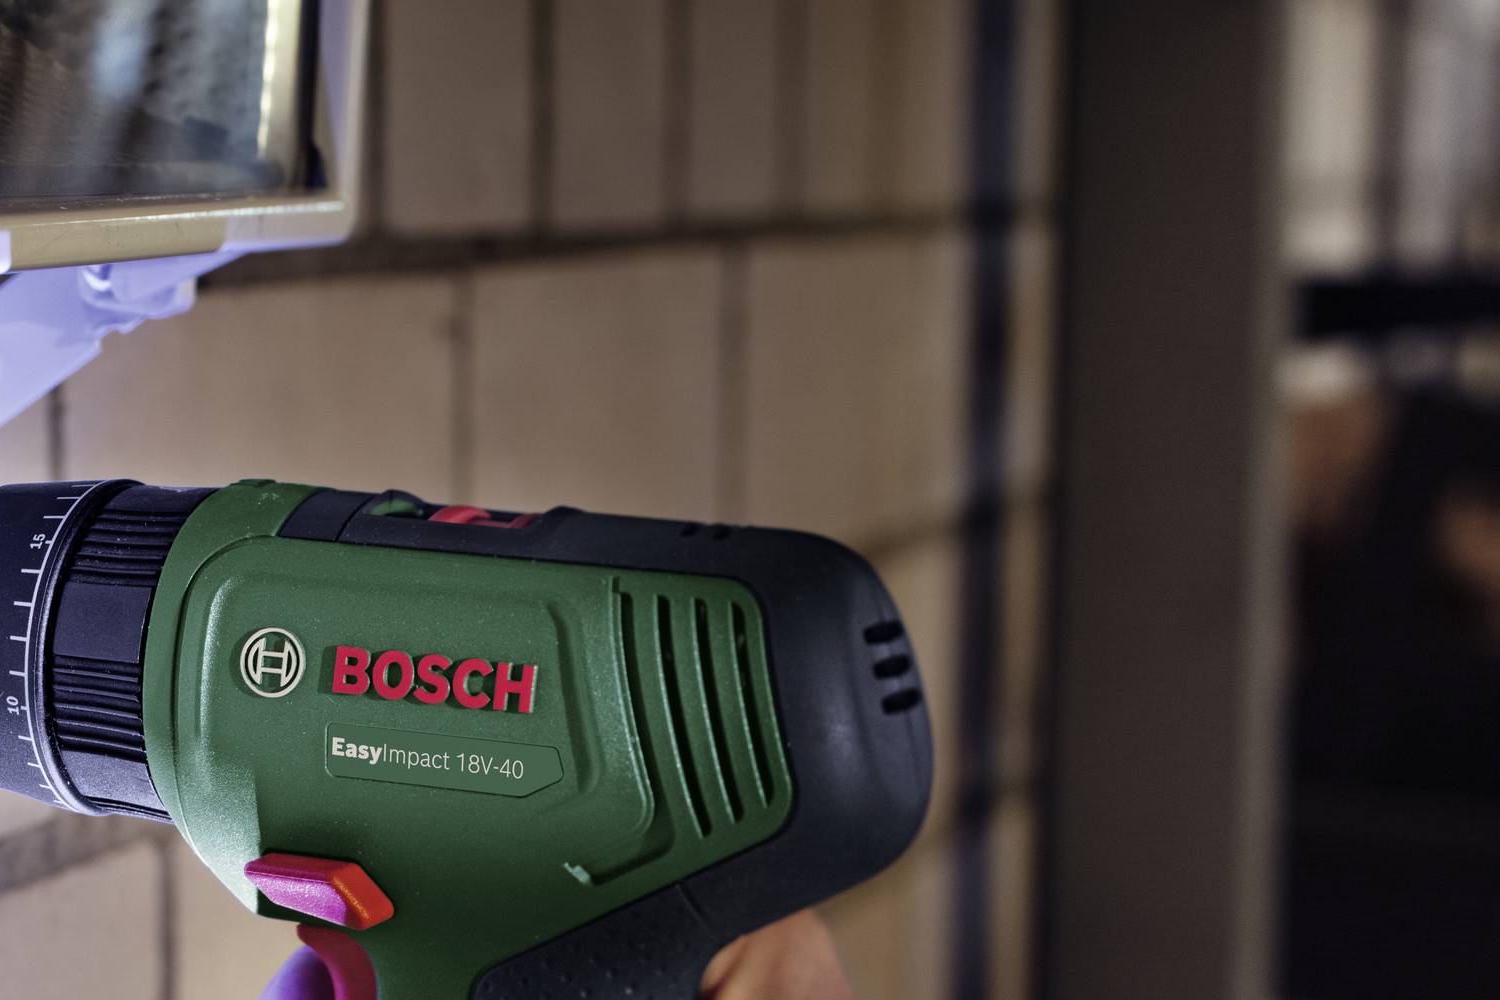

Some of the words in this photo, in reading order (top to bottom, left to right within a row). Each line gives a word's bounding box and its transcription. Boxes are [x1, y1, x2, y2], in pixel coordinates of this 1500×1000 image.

[29, 532, 47, 551] 15
[331, 644, 538, 714] BOSCH
[6, 695, 20, 716] 10
[331, 736, 451, 770] EasyImpact
[456, 752, 525, 780] 18V-40
